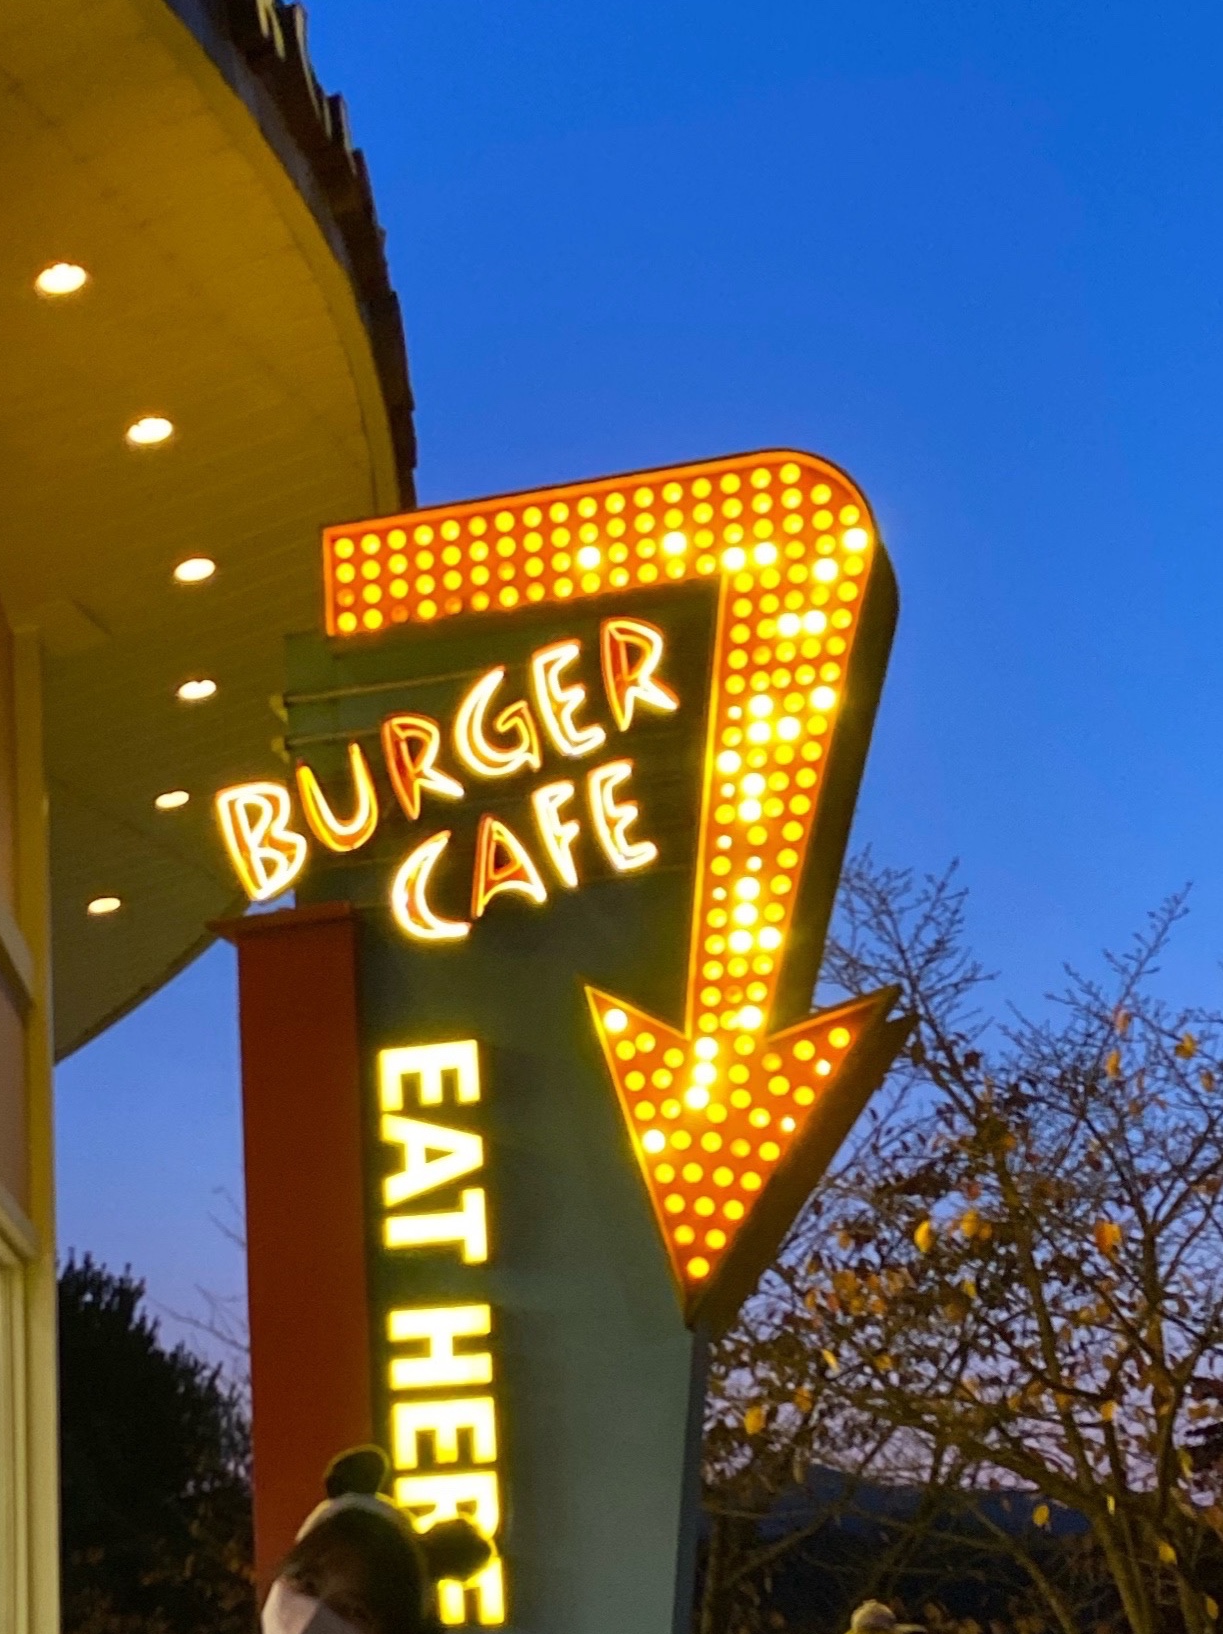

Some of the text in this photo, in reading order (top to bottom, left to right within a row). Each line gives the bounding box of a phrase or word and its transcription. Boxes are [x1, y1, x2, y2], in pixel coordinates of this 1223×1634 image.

[216, 616, 679, 901] BURGER
[391, 759, 658, 940] CAFE
[378, 1039, 488, 1264] EAT
